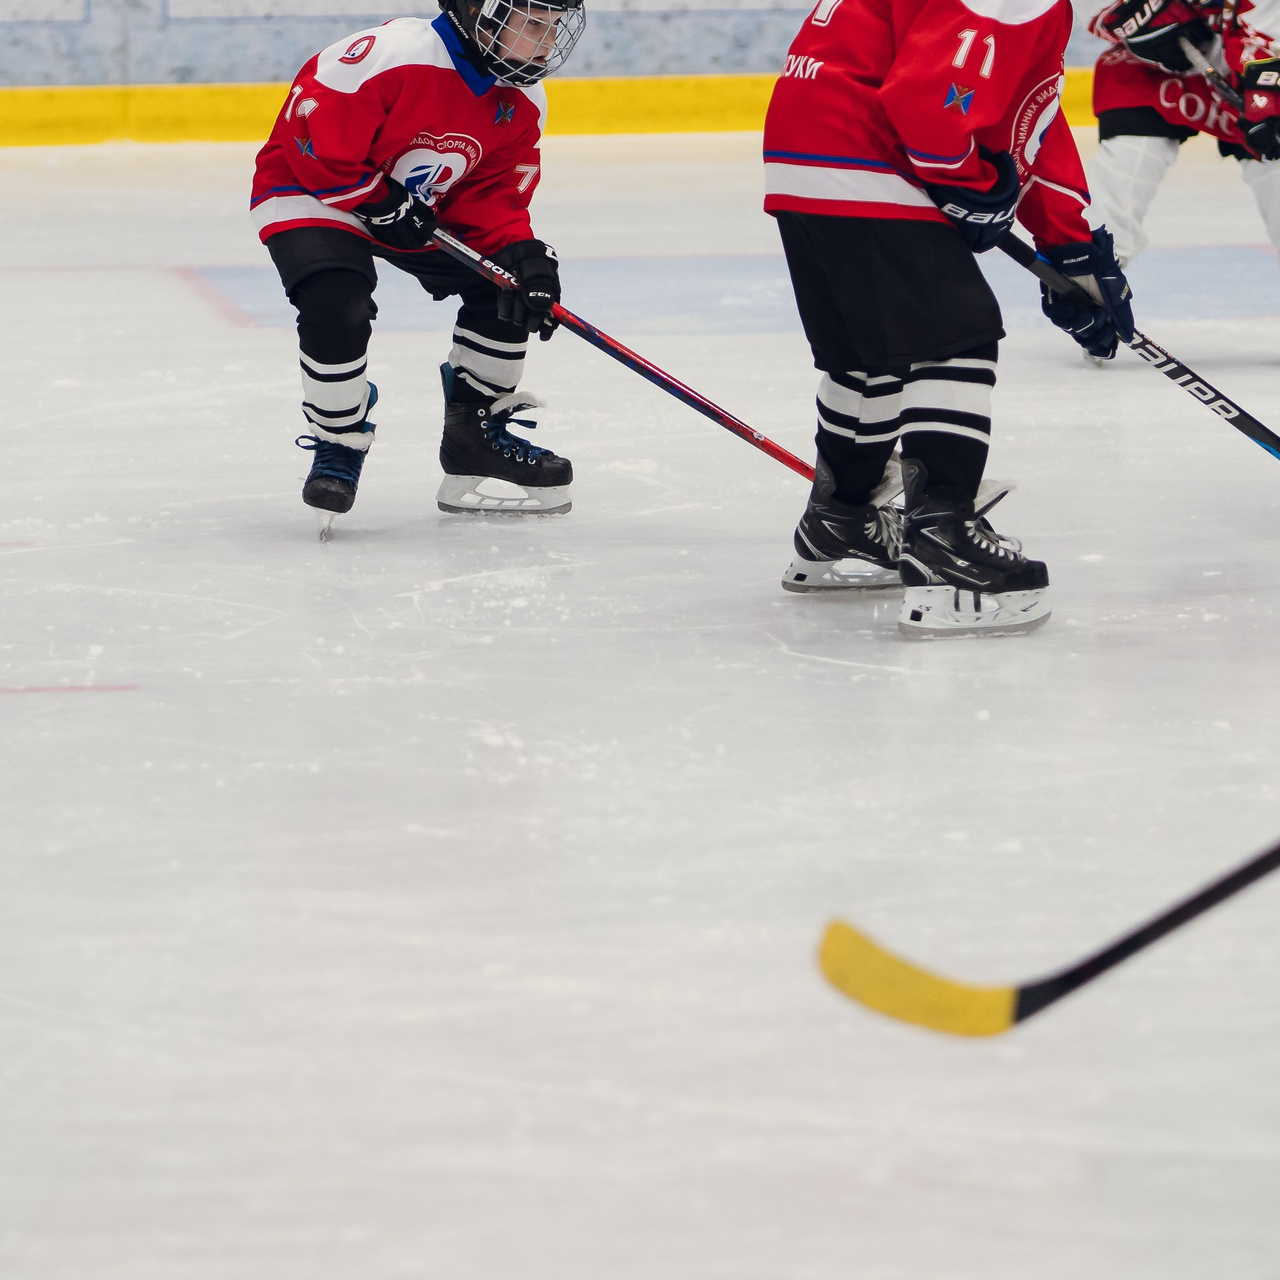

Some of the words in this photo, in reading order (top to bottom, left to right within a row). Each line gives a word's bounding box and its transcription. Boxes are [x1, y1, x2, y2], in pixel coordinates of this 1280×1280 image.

[447, 10, 469, 39] BAUER
[952, 28, 995, 79] 11
[1017, 102, 1039, 144] ЗИМНИХ
[513, 163, 540, 194] 7
[1063, 254, 1089, 264] BAUER
